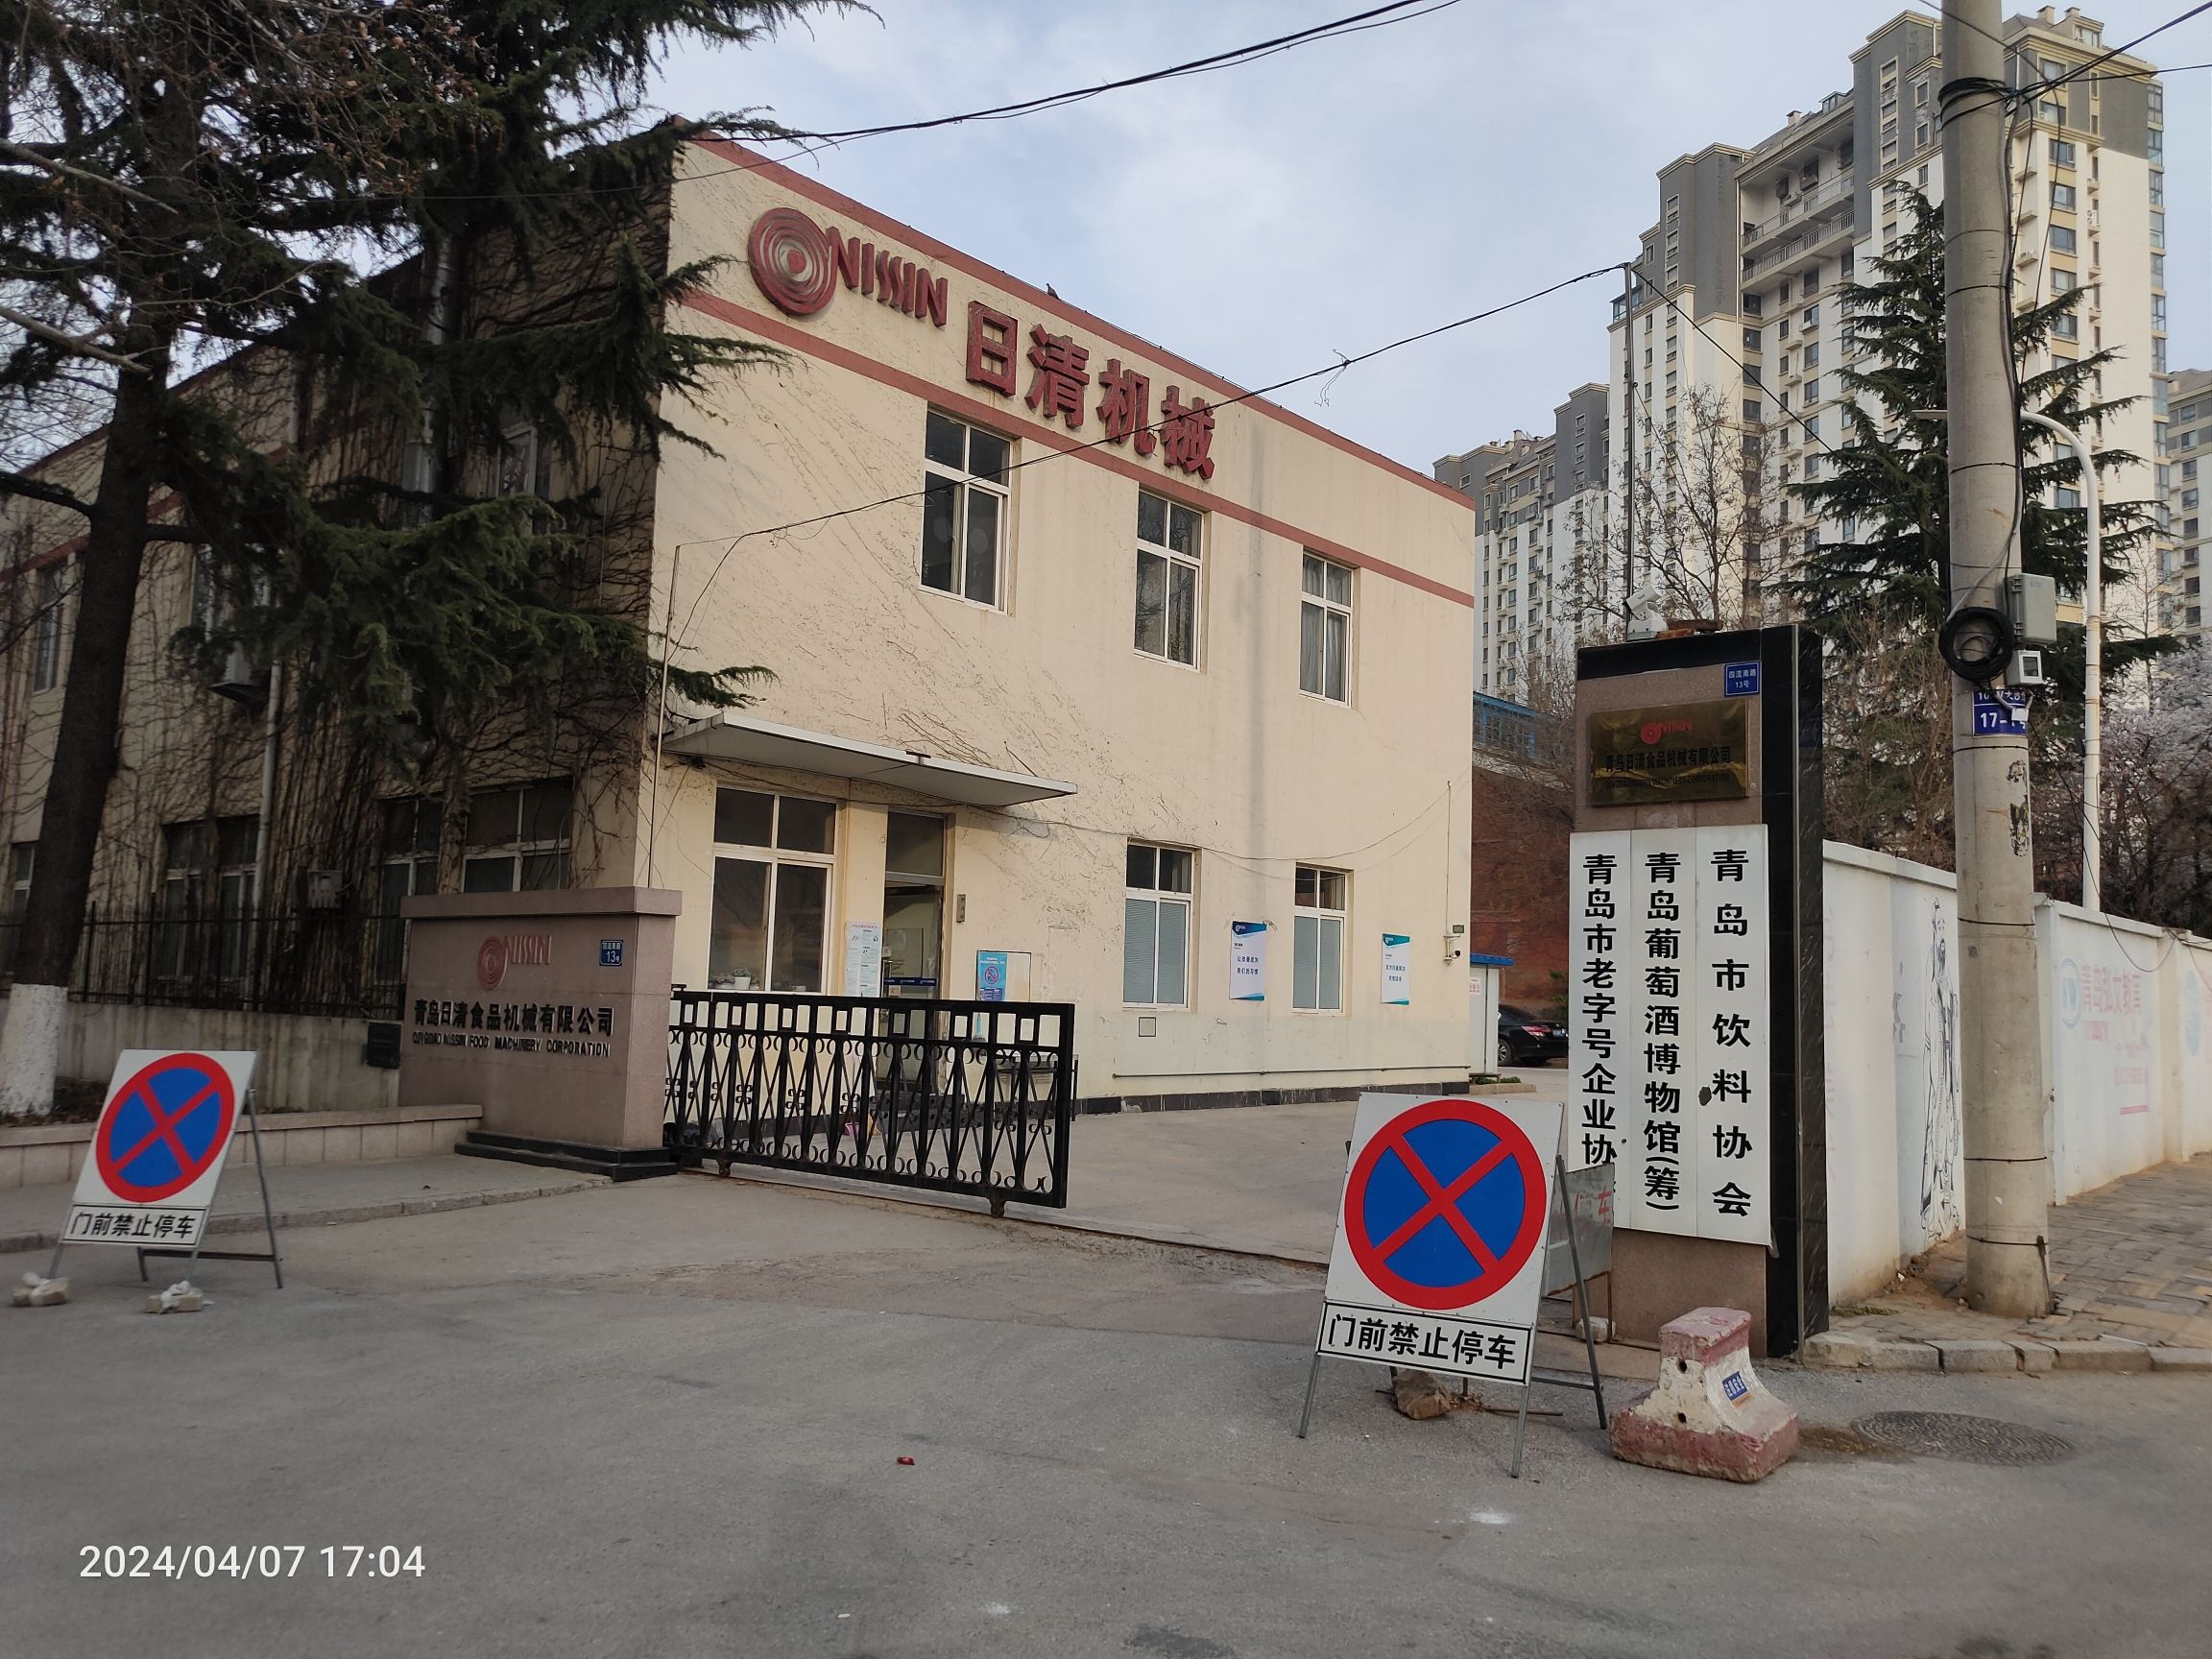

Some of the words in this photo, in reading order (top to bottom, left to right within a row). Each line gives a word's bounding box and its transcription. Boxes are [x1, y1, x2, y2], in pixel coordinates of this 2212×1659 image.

[826, 227, 948, 326] NISSIN
[966, 301, 1214, 480] 日清机械
[1735, 680, 1749, 688] 13号
[1605, 747, 1730, 772] 青岛日清食品机械有限公司
[504, 935, 552, 965] NISSIN
[414, 998, 615, 1037] 青岛日清食品机械有限公司
[1581, 854, 1617, 1193] 青岛市老字号企业协
[1711, 849, 1752, 1216] 青岛市饮料协会
[469, 1034, 490, 1048] FOOD
[494, 1036, 541, 1052] MACHINERY
[546, 1039, 611, 1057] CORPORATION
[70, 1212, 196, 1238] 门前禁止停车
[1329, 1313, 1516, 1369] 门前禁止停车
